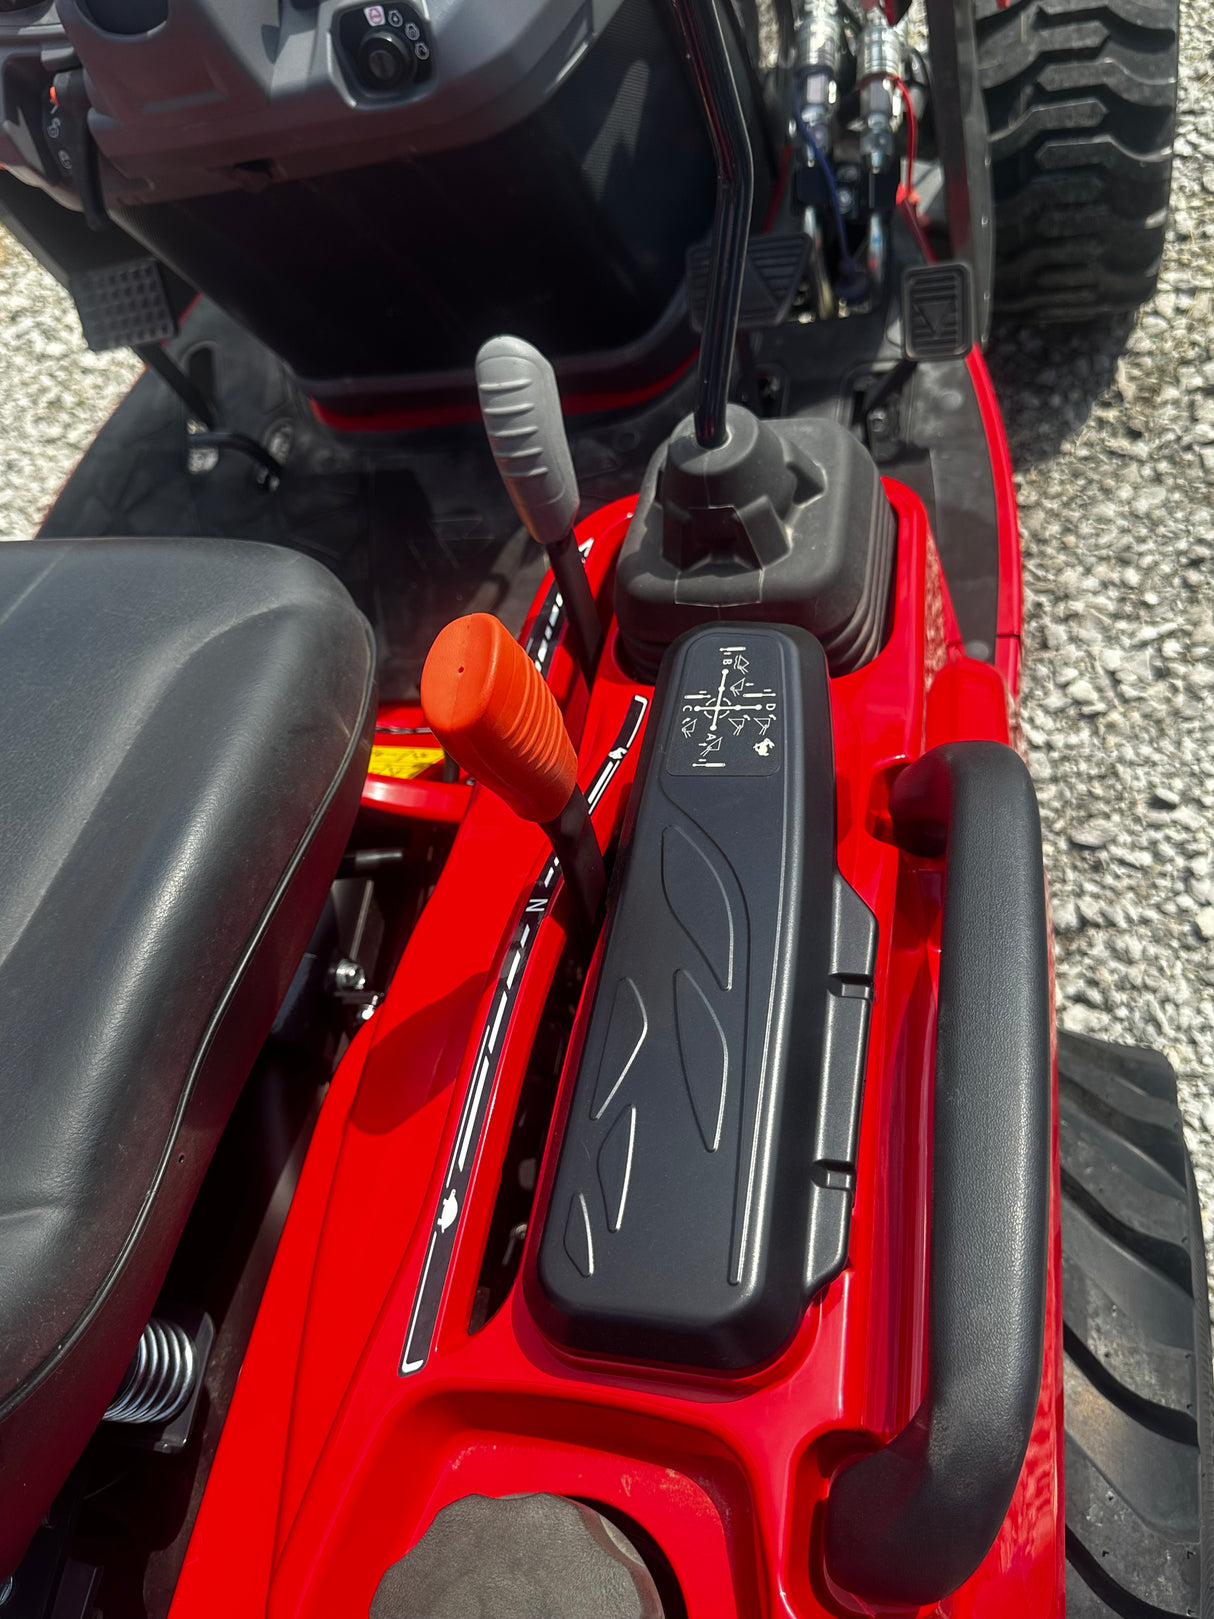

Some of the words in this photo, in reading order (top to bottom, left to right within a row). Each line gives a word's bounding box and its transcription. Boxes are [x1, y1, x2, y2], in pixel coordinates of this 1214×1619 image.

[722, 658, 733, 666] B
[682, 704, 693, 712] C
[765, 703, 777, 711] D
[705, 733, 717, 741] A
[525, 898, 549, 912] N
